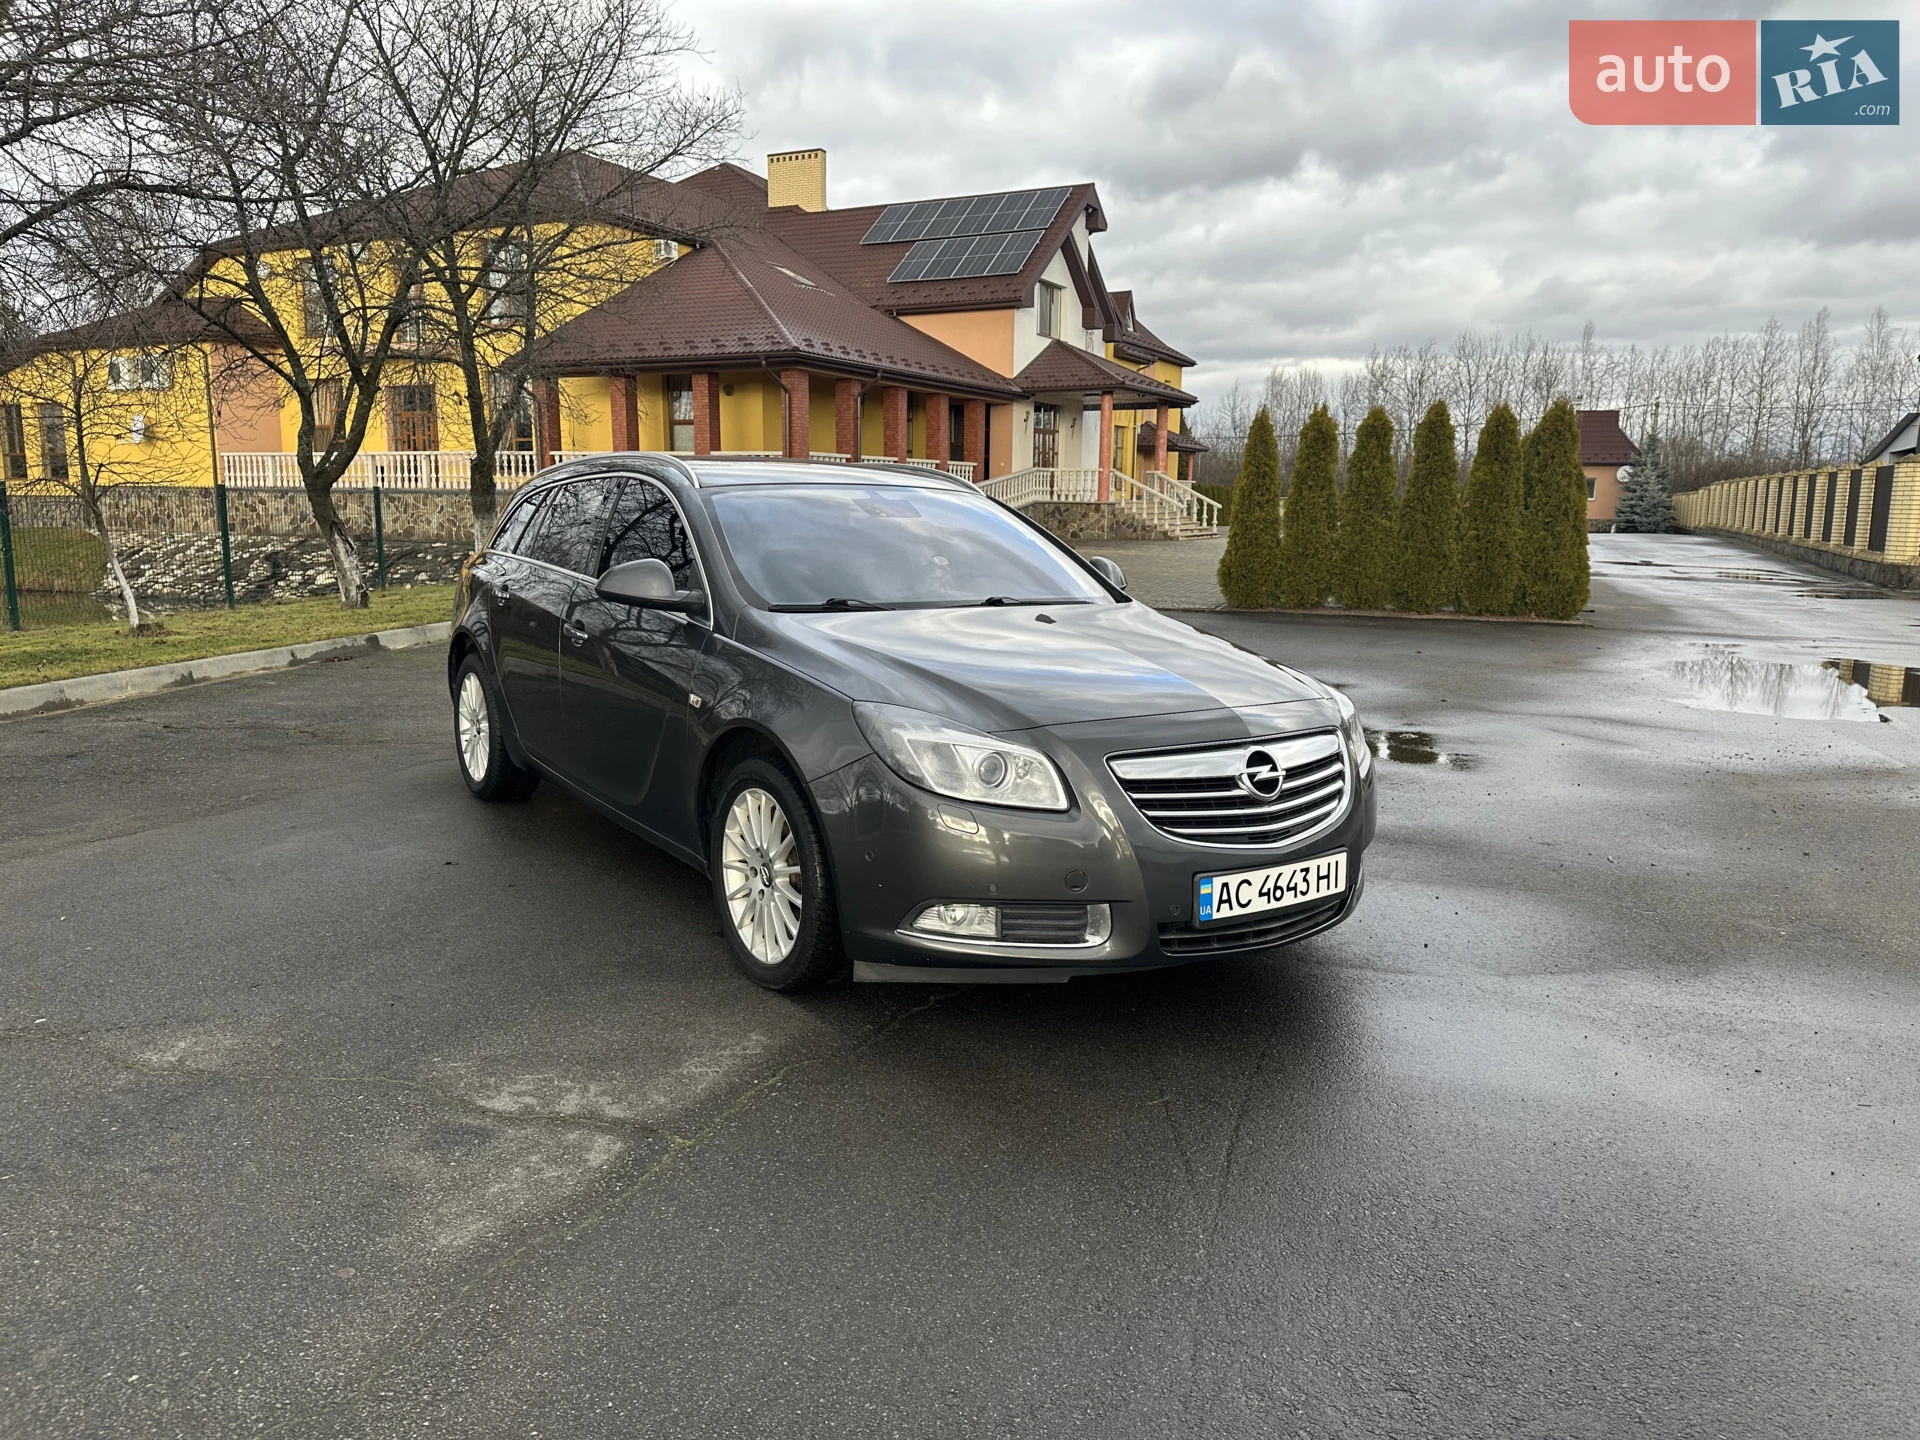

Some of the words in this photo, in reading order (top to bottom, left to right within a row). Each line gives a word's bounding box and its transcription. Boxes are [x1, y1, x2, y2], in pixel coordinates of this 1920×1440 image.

[1216, 879, 1253, 913] AC
[1258, 866, 1310, 904] 4643
[1316, 860, 1339, 893] HI
[1200, 905, 1212, 916] UA
